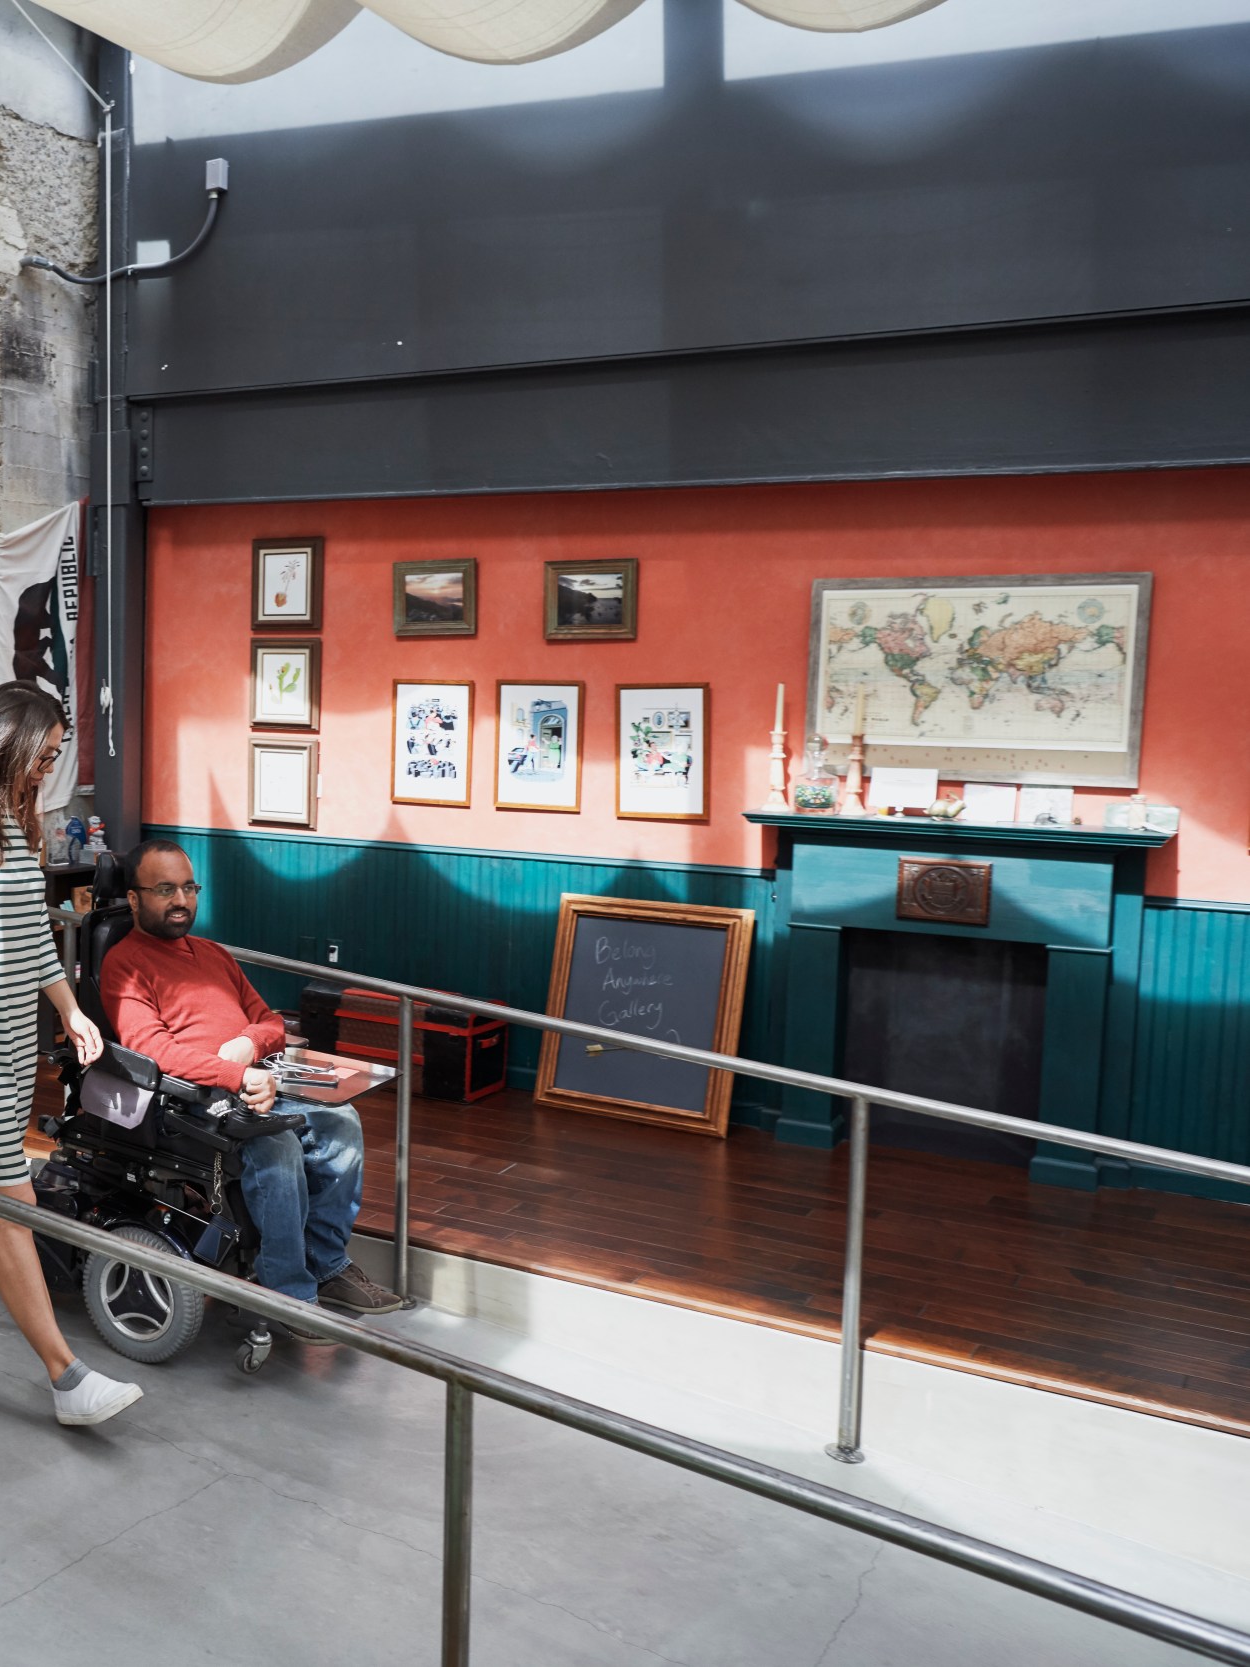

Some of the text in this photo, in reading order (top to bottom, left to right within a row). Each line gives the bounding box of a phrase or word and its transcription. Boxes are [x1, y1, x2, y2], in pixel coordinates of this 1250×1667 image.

[595, 936, 656, 970] Belong
[602, 967, 674, 995] Anywhere
[598, 1000, 663, 1030] Gallery
